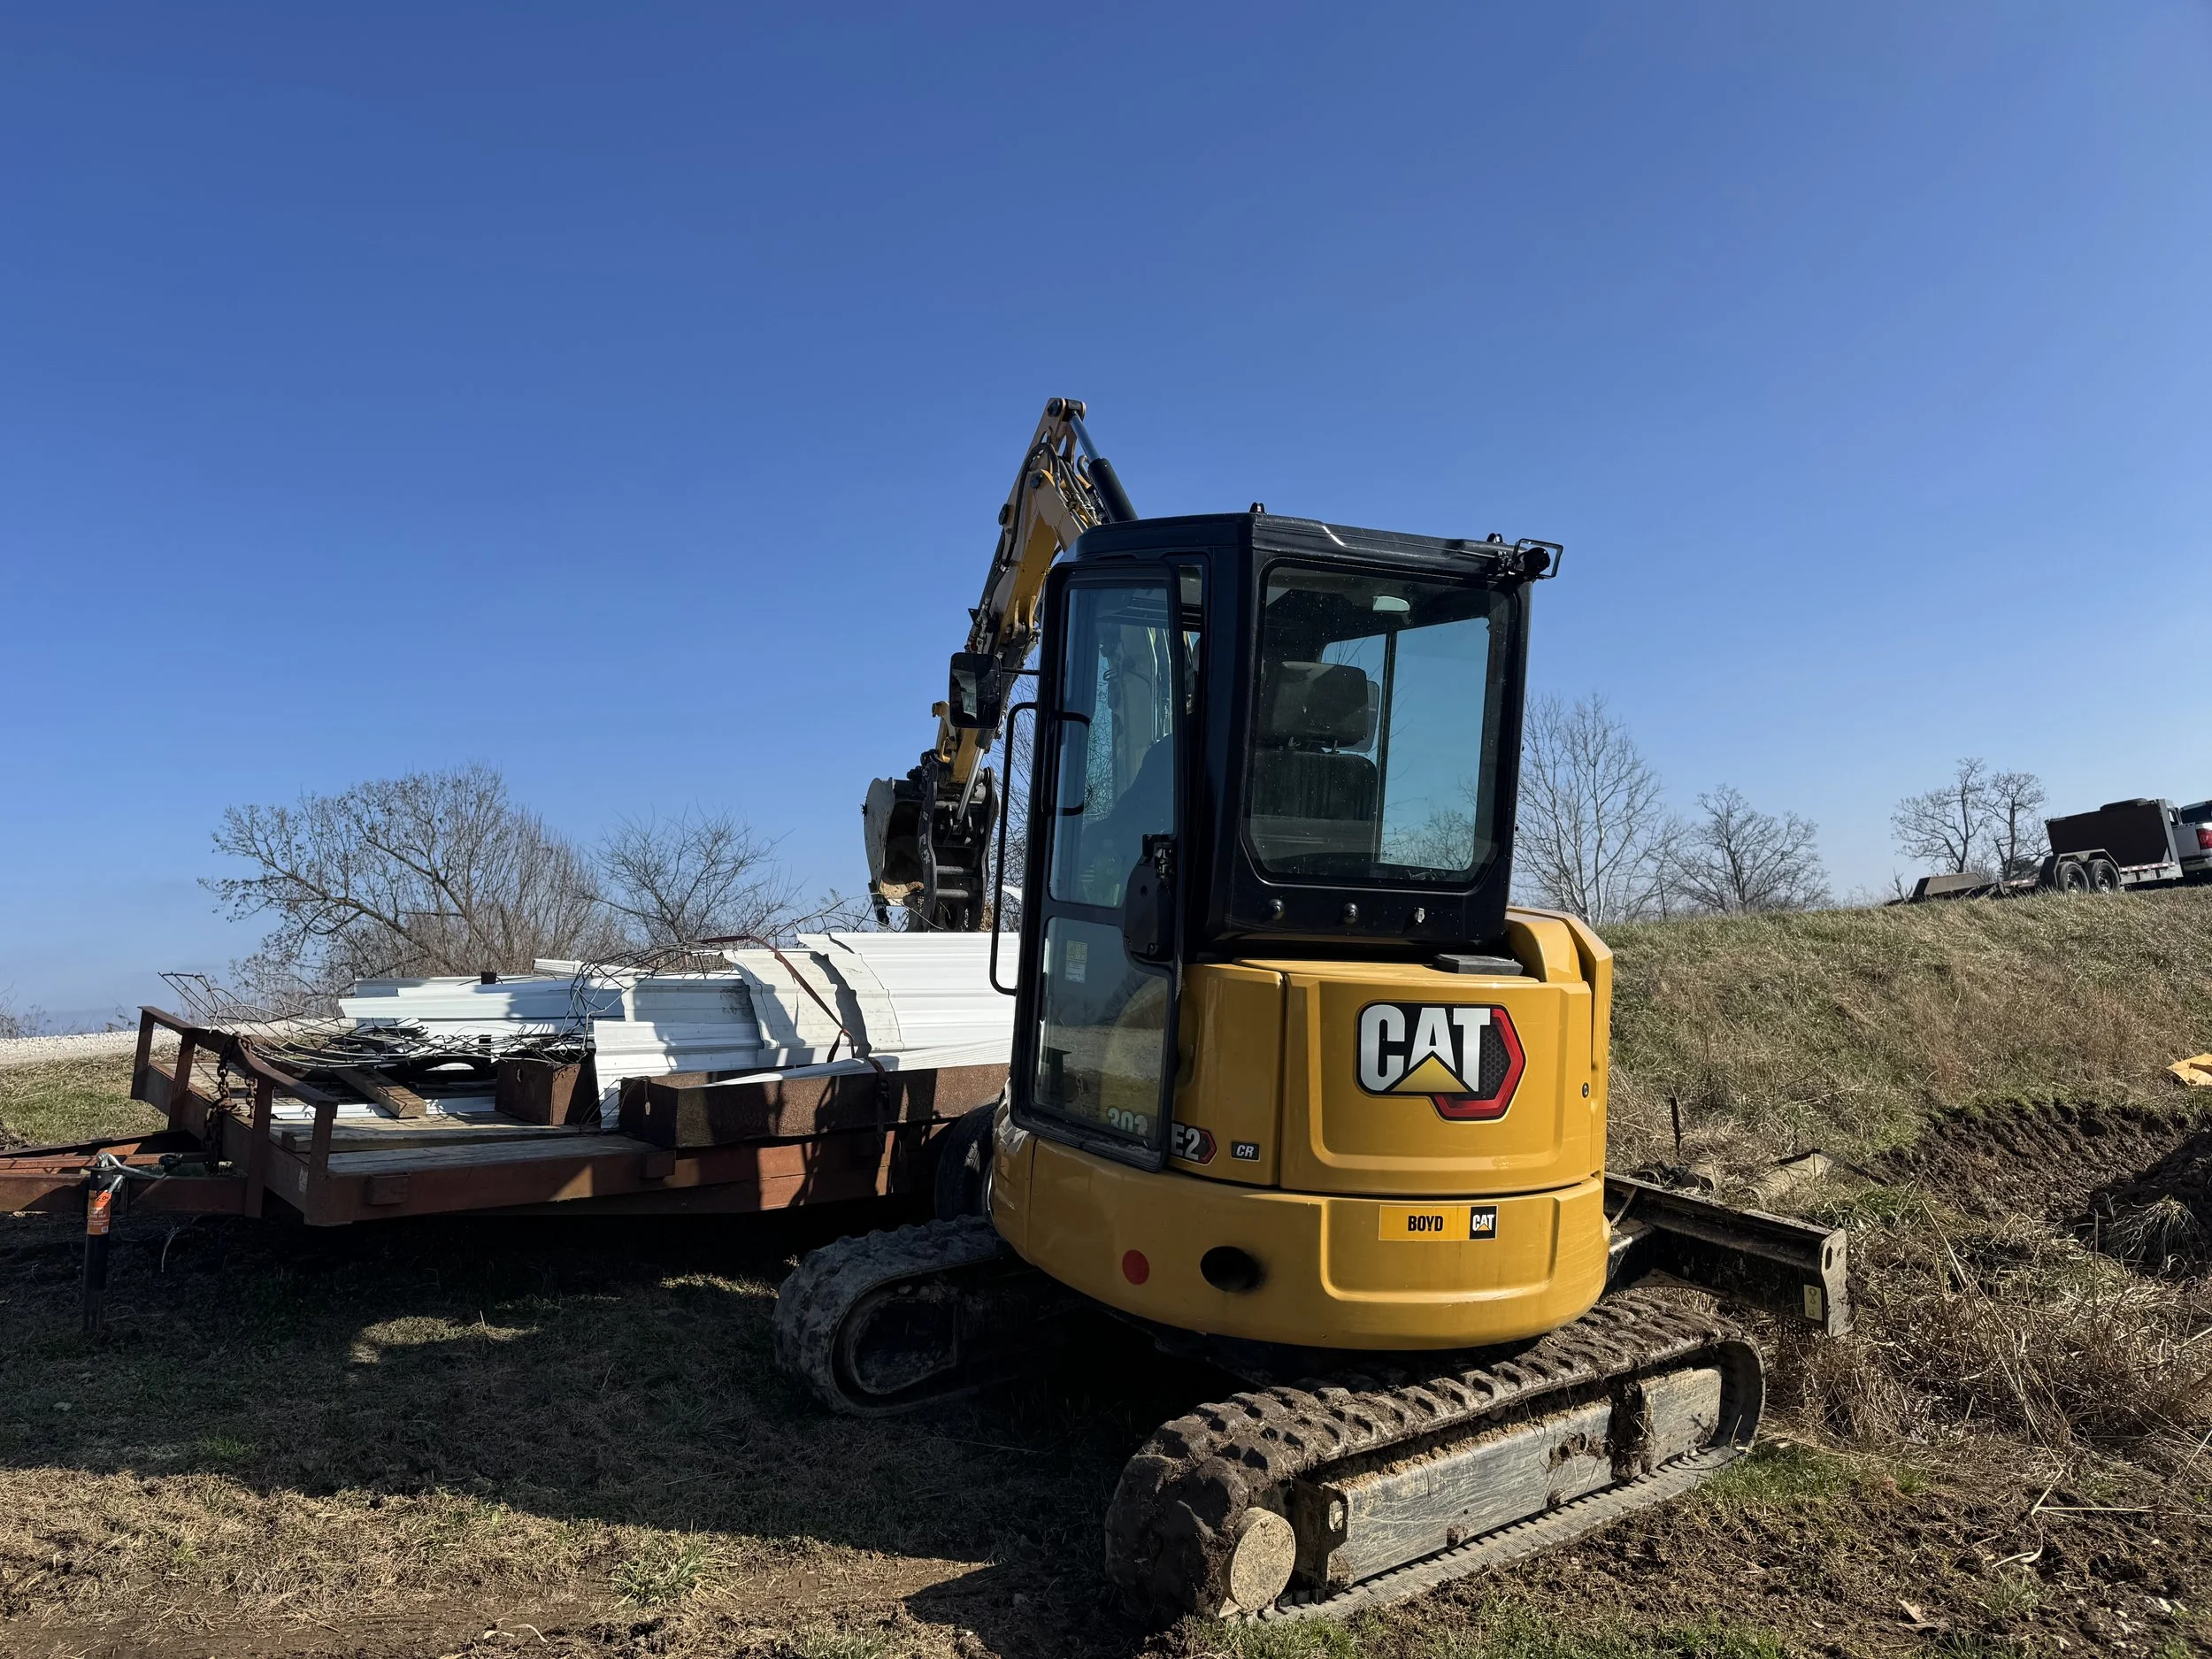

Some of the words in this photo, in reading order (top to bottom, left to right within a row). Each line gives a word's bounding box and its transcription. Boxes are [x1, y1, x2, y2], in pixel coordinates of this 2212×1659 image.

[1361, 1004, 1490, 1093] CAT
[1236, 1144, 1255, 1157] CR
[1408, 1215, 1444, 1232] BOYD
[1471, 1214, 1495, 1232] CAT
